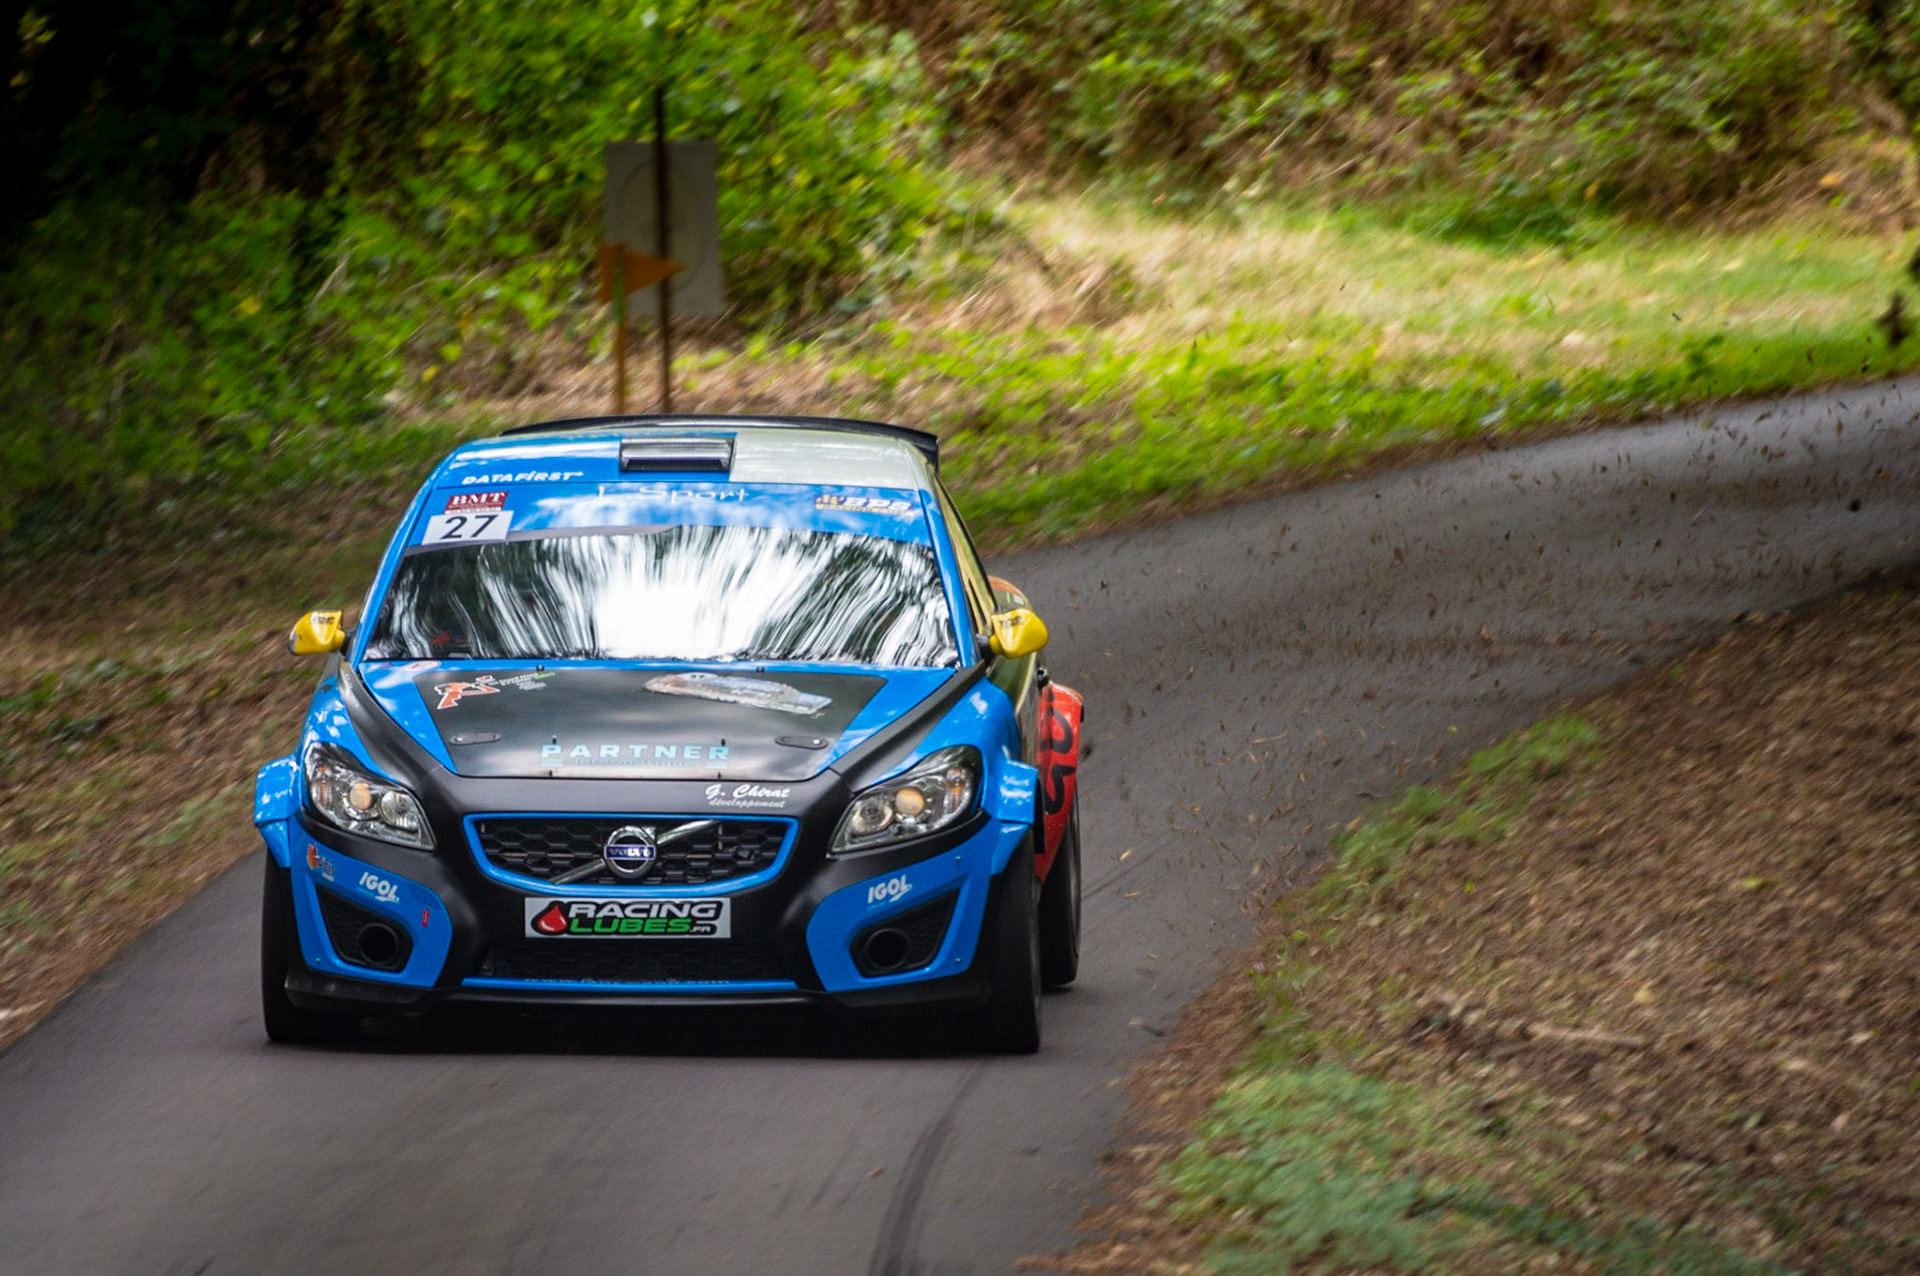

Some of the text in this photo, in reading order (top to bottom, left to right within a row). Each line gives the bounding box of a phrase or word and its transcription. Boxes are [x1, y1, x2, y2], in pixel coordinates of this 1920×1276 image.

[842, 496, 913, 511] BPS
[440, 514, 499, 540] 27
[541, 744, 729, 760] PARTNER
[732, 784, 790, 798] Chirat
[359, 872, 399, 902] IGOL
[867, 874, 912, 903] IGOL
[568, 903, 718, 918] RACING
